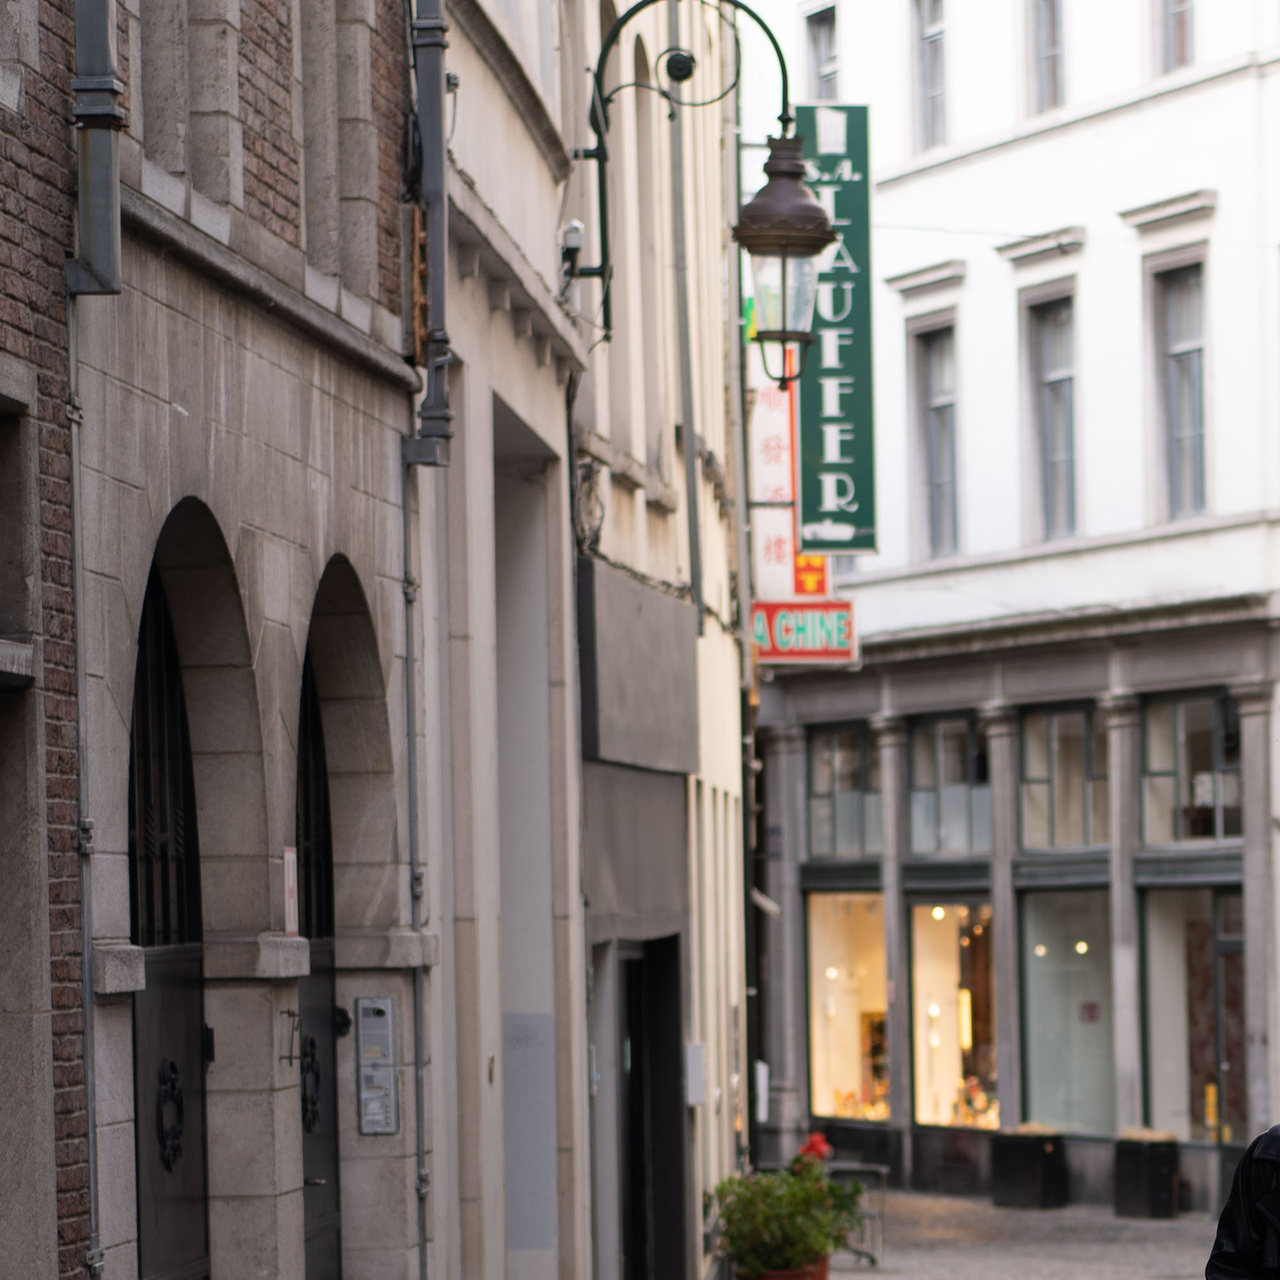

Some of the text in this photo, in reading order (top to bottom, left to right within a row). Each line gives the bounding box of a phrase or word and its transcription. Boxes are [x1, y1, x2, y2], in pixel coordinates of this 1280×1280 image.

[804, 158, 862, 182] S.A.
[816, 186, 859, 513] LAUFFER
[774, 611, 850, 649] CHINE
